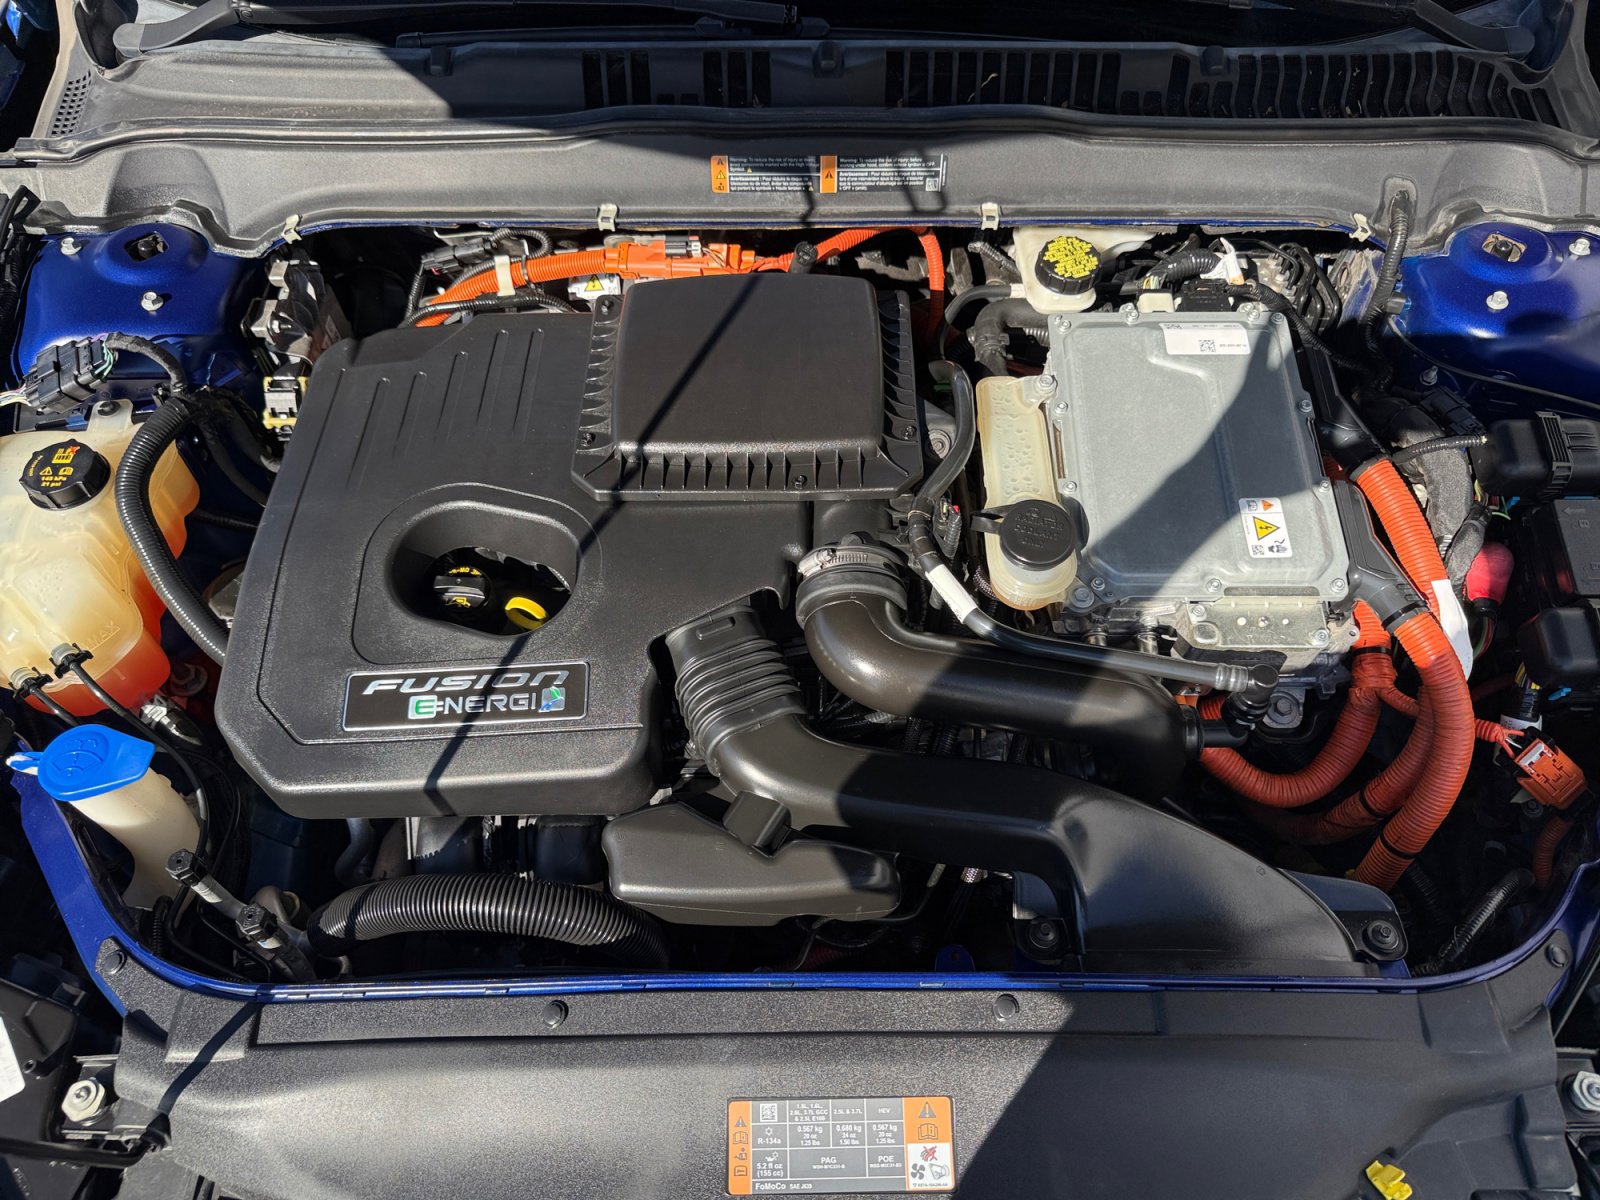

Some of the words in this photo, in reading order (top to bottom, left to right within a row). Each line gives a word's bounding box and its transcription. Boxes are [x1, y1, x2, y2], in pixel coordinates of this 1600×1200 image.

[362, 670, 570, 695] FUSION
[408, 692, 536, 720] ENERGI
[814, 1125, 823, 1133] kg
[854, 1124, 862, 1132] kg
[890, 1123, 897, 1132] kg
[757, 1170, 771, 1178] (155
[772, 1169, 783, 1177] cc)
